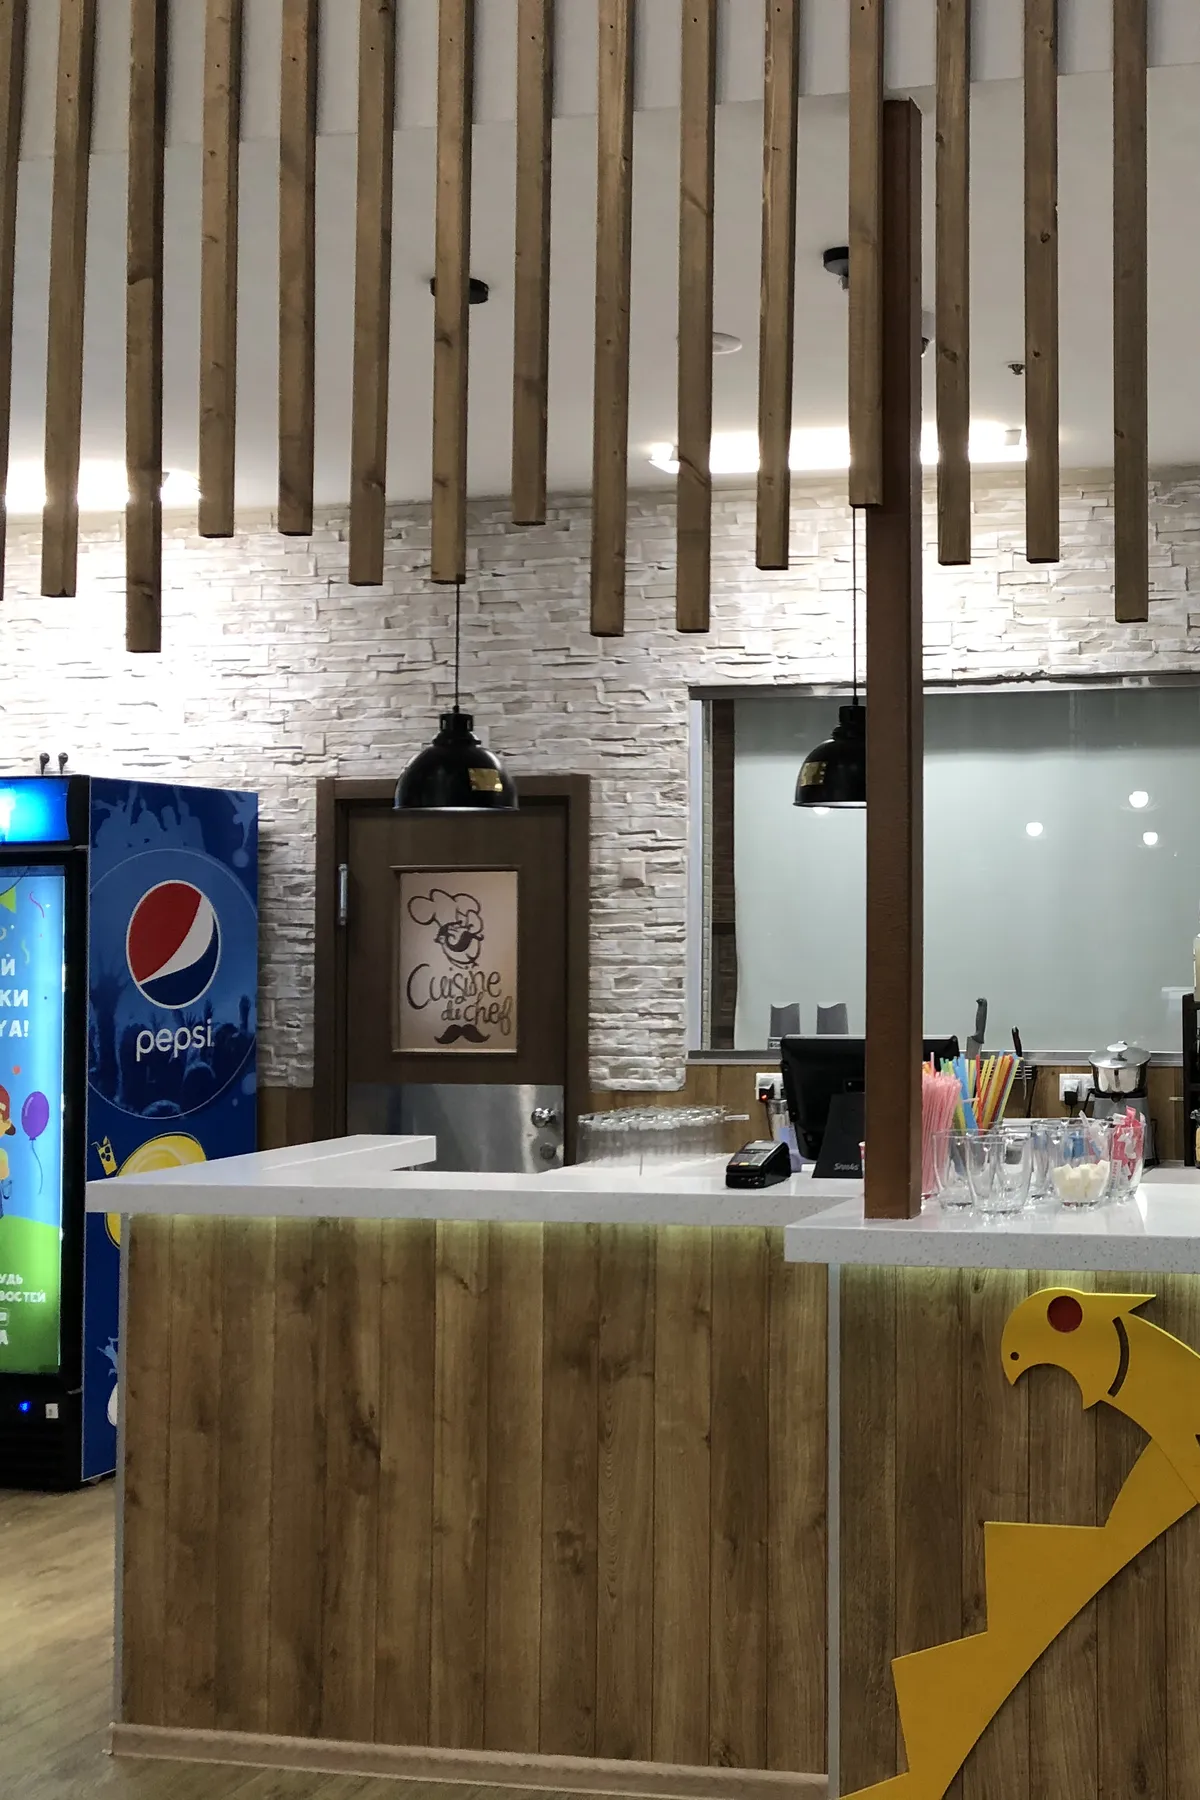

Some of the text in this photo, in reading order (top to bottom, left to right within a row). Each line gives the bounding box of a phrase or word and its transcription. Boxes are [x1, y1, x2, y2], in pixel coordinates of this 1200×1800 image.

[407, 963, 502, 1010] Cuisine
[463, 991, 513, 1036] chef
[136, 1018, 213, 1062] pepsi
